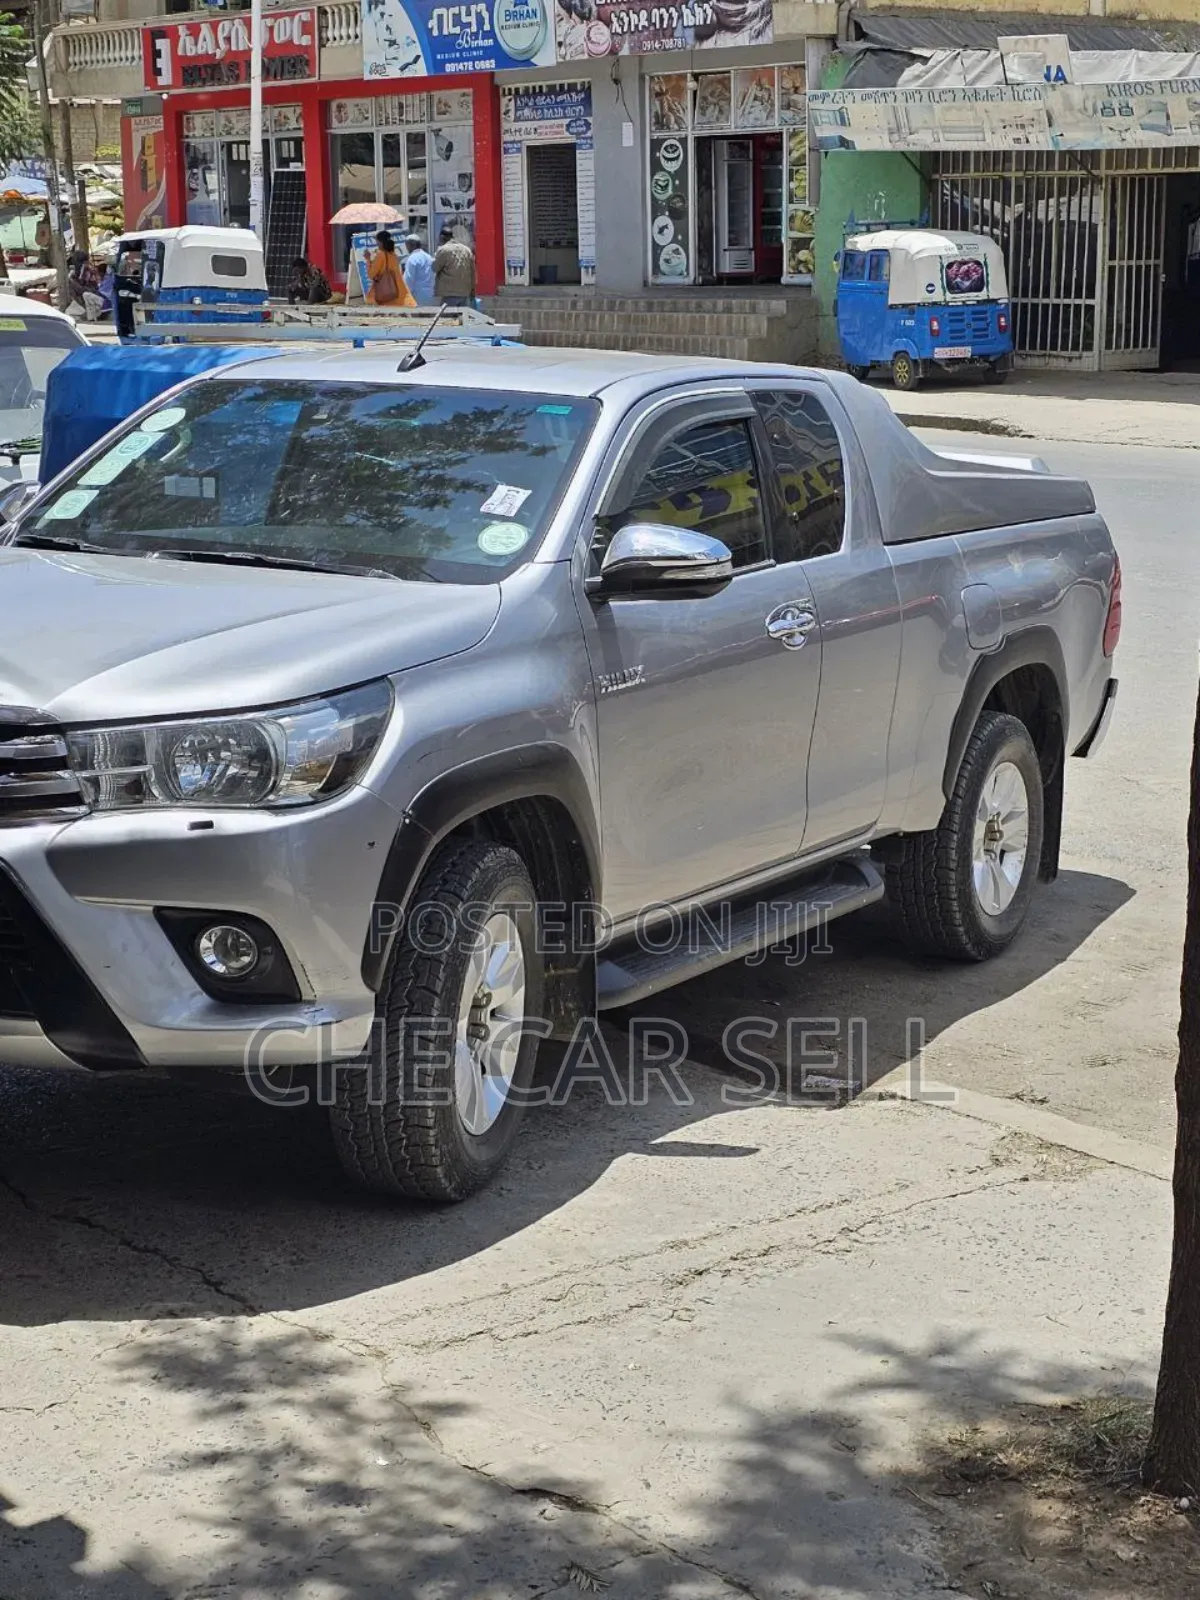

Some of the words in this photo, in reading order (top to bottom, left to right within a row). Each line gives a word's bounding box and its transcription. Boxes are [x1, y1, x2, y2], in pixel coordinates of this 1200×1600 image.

[427, 3, 491, 37] ብርሃን
[455, 28, 495, 50] Birhan
[1105, 82, 1155, 98] KIROS
